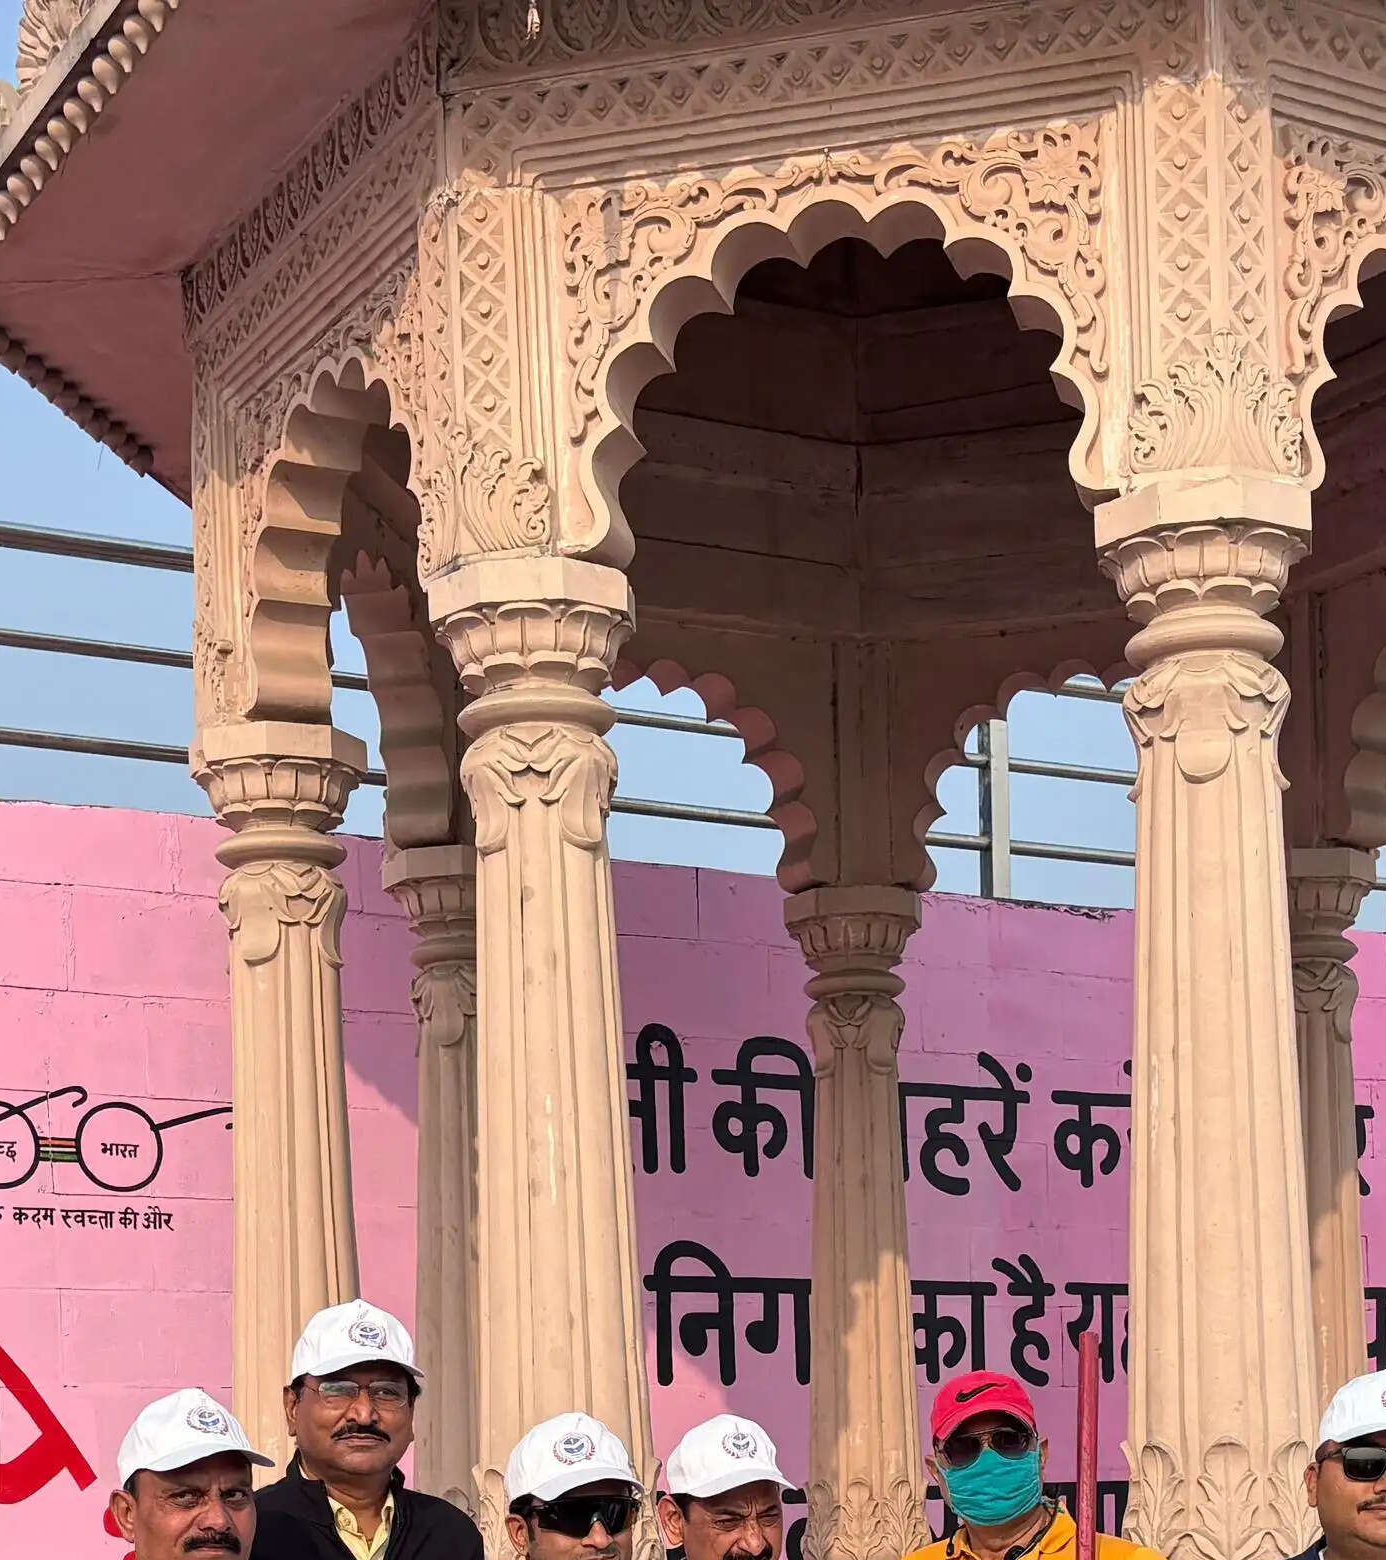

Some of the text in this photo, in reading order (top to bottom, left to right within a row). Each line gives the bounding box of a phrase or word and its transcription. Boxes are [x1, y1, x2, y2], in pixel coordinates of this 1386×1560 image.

[100, 1142, 140, 1159] भारत
[12, 1206, 56, 1229] कदम
[118, 1206, 140, 1230] की
[991, 1254, 1055, 1387] है
